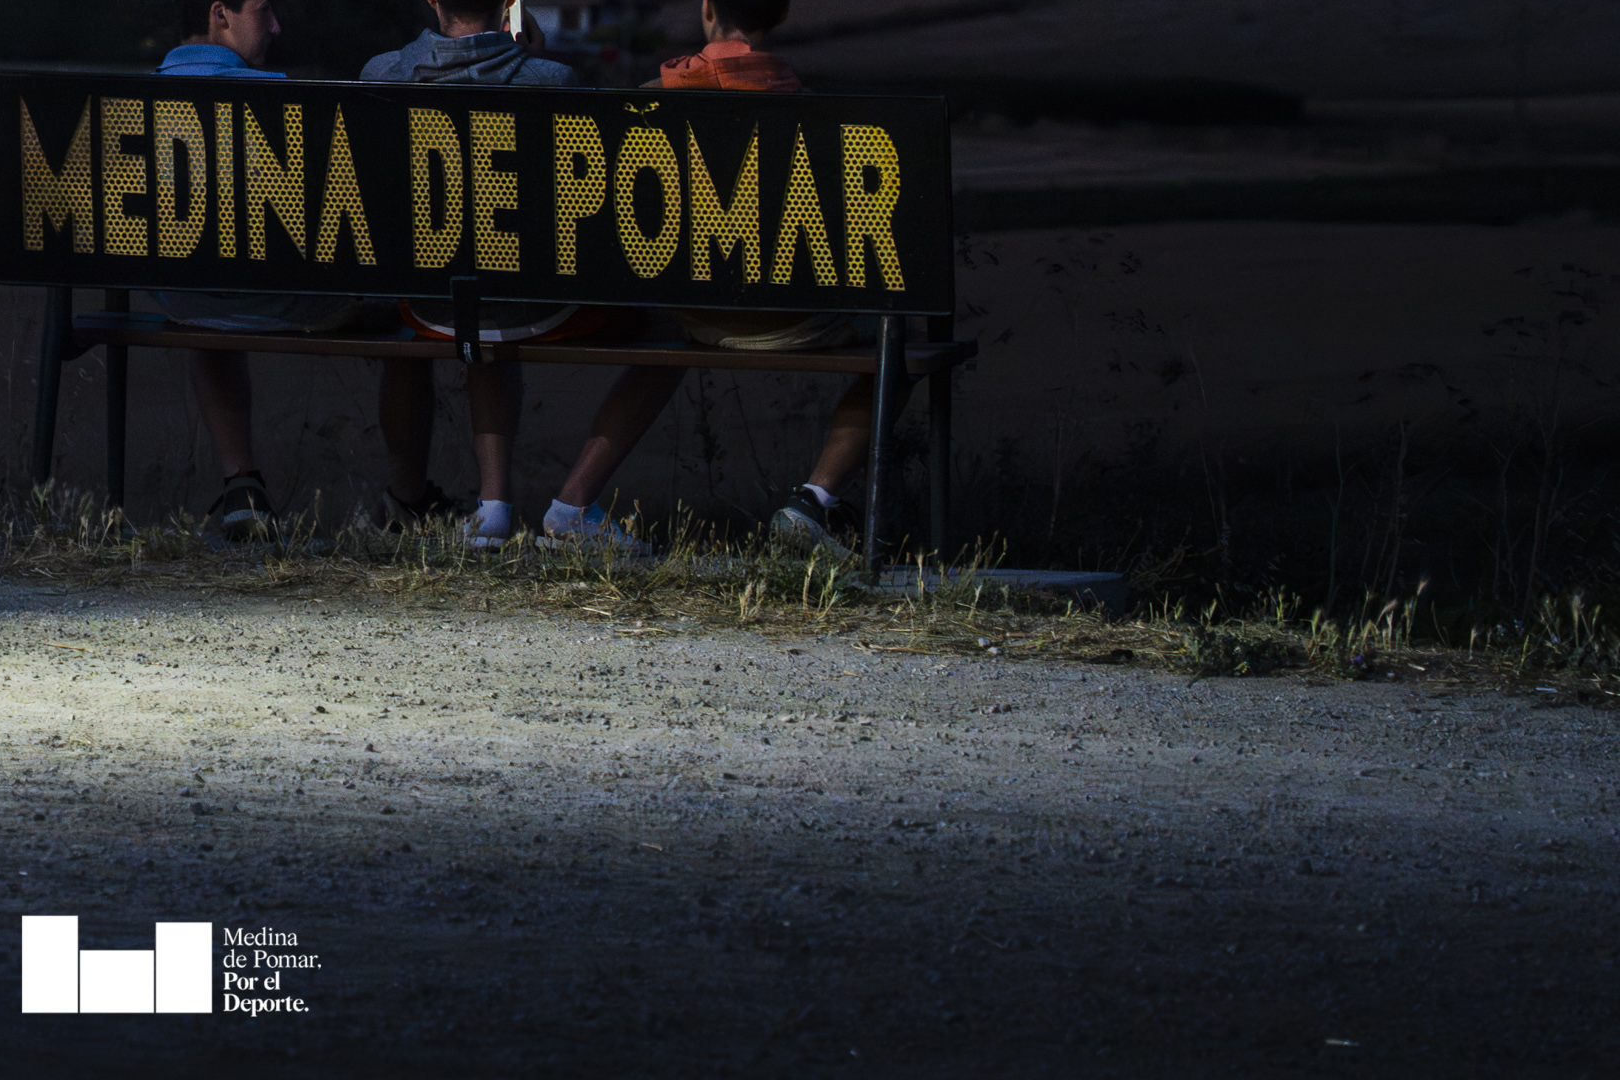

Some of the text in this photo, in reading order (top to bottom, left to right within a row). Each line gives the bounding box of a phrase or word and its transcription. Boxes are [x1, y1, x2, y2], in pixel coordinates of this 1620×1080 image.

[20, 95, 907, 292] MEDINA DE POMAR
